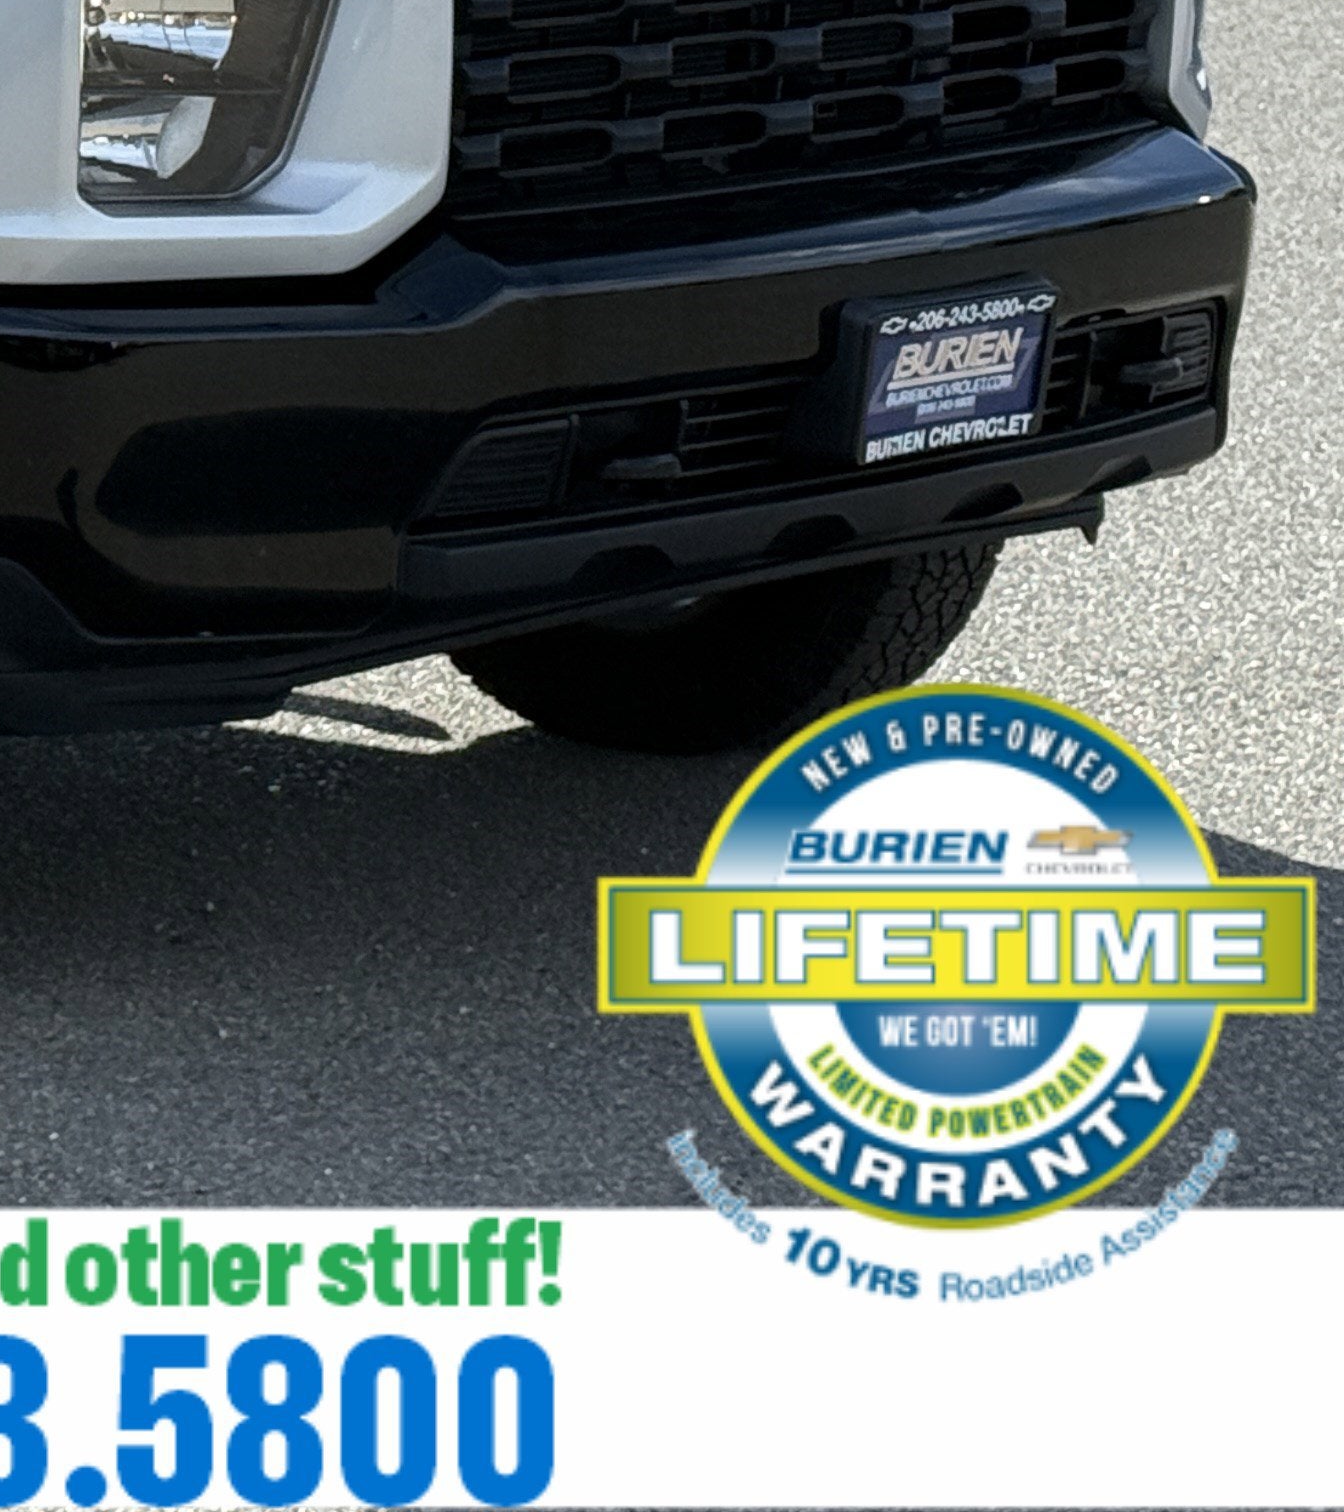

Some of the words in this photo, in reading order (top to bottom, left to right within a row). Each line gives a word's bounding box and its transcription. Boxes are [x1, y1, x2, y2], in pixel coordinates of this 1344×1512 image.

[892, 327, 1025, 380] BURIEN
[865, 429, 927, 463] BURIEN
[929, 412, 1034, 448] CHEVROLET
